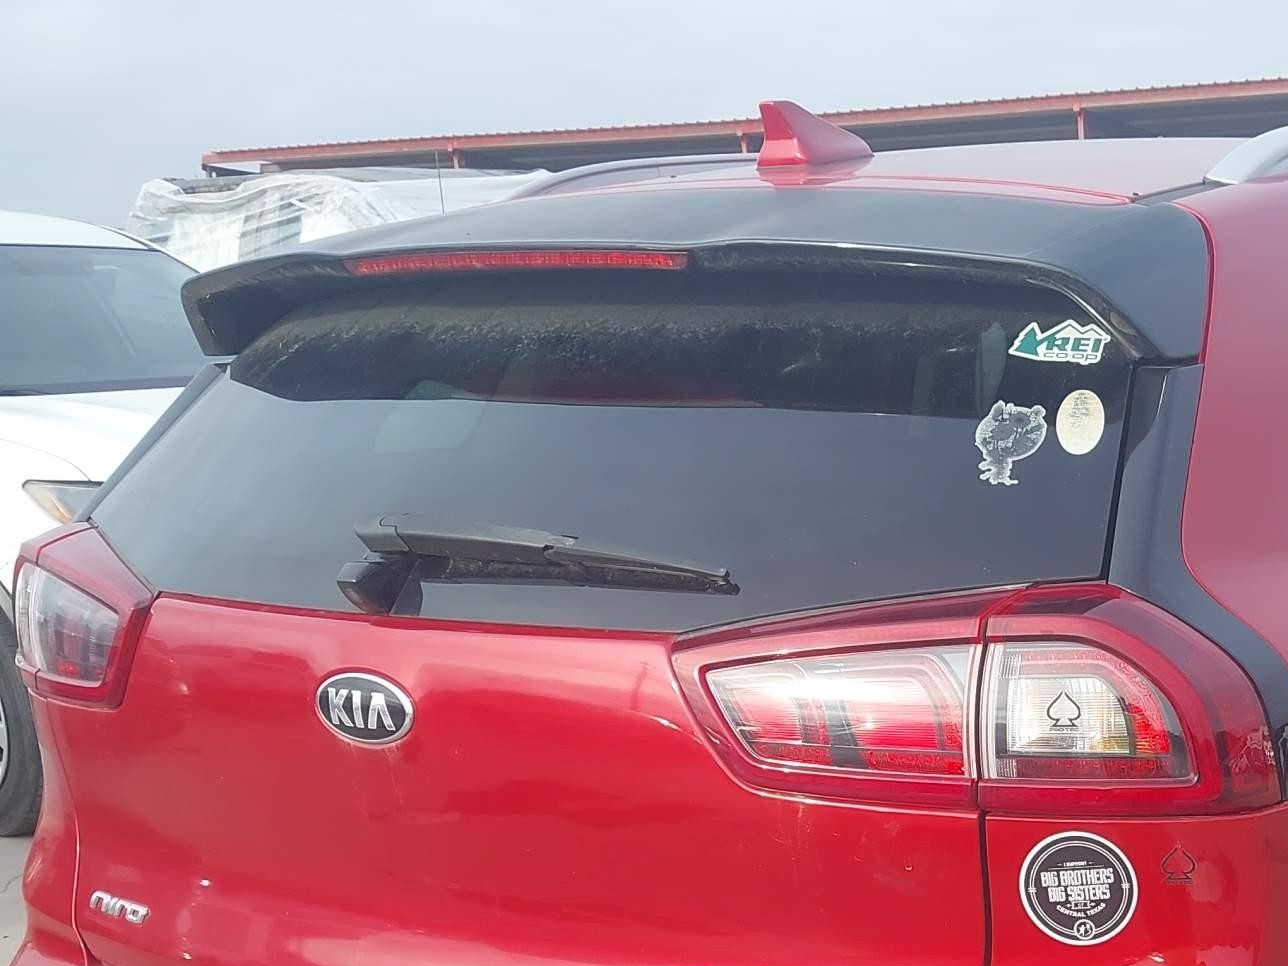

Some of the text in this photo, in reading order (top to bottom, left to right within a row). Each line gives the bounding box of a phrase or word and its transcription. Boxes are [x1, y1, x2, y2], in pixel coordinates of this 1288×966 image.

[1045, 335, 1103, 353] REI
[327, 687, 396, 731] KIA
[1040, 868, 1115, 887] BIG BROTHERS
[1047, 884, 1111, 903] BIG SISTERS
[1056, 904, 1086, 918] CENTRAL
[1086, 902, 1106, 916] TEXAS
